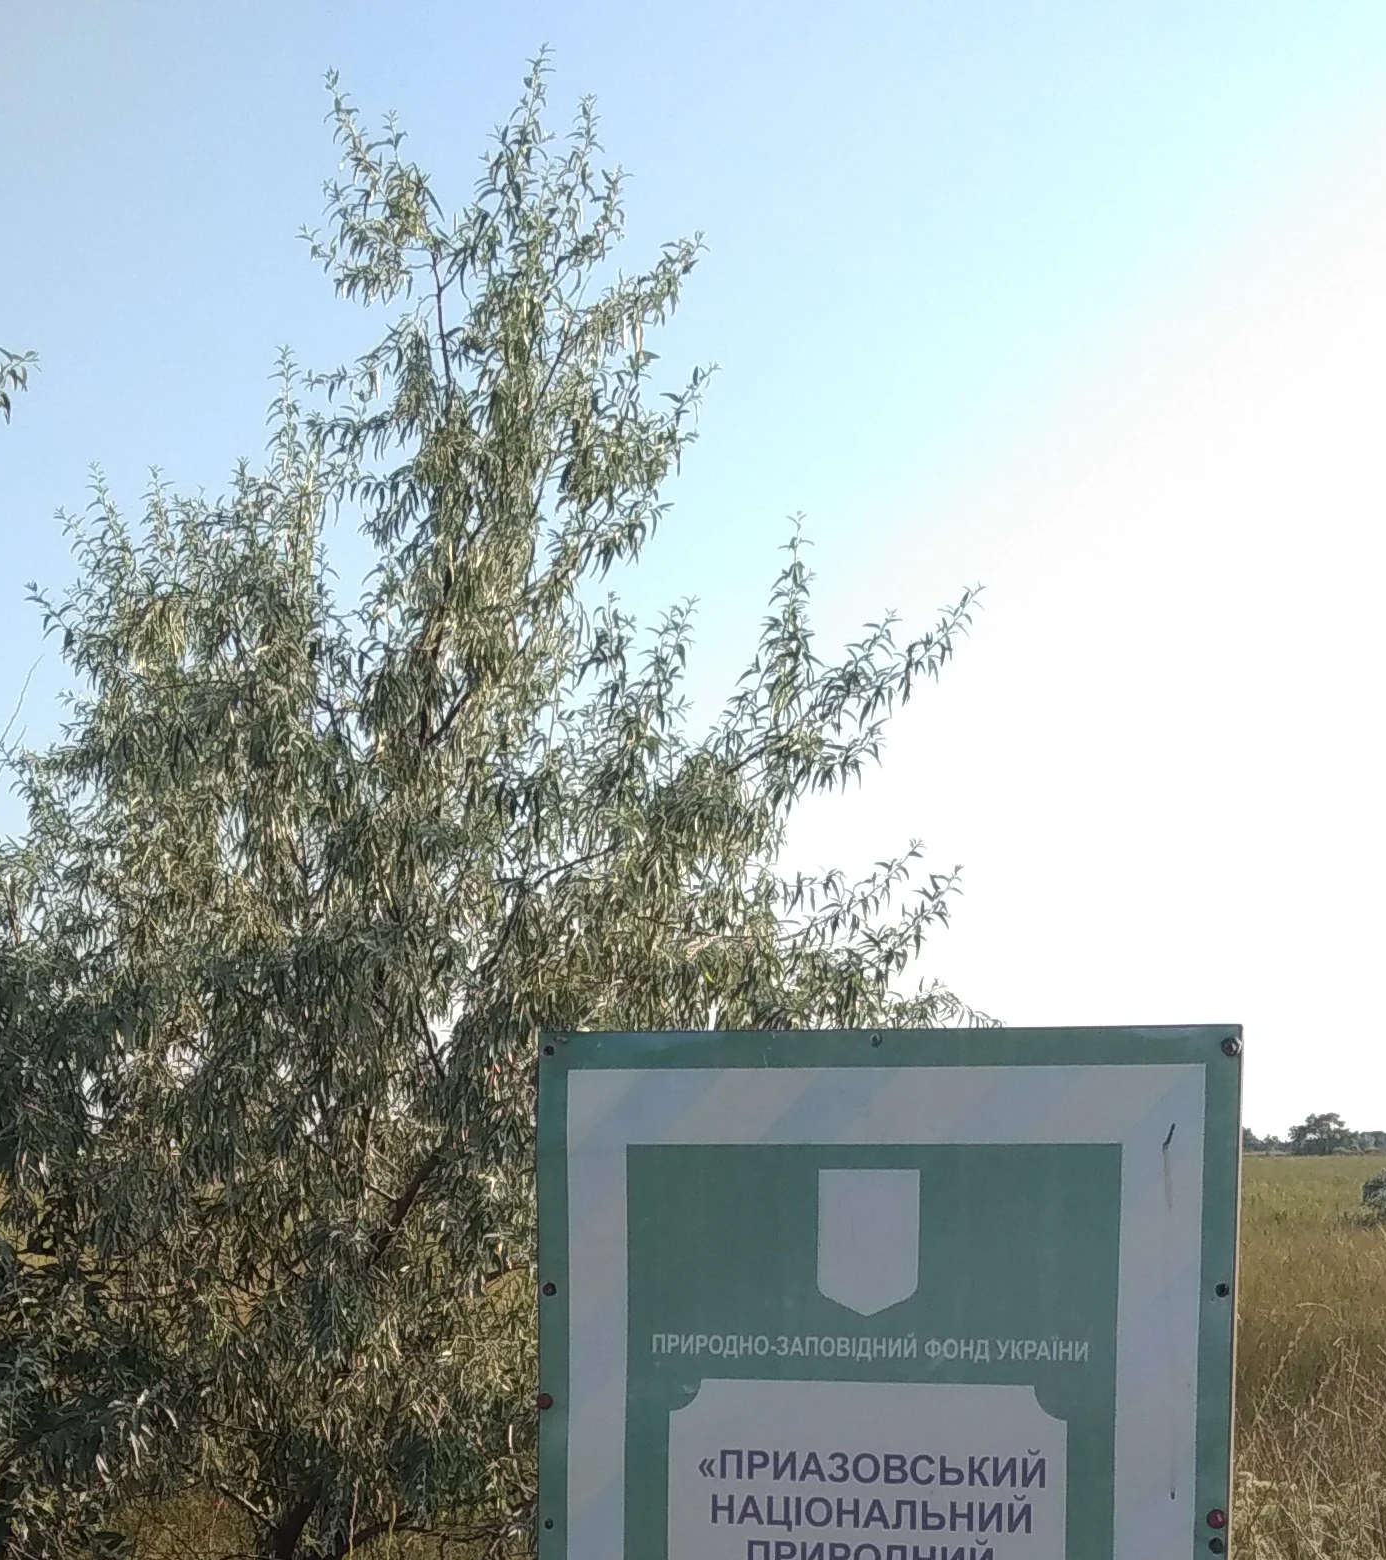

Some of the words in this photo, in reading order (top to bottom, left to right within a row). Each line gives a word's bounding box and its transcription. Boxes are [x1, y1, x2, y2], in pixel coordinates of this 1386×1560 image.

[651, 1332, 918, 1363] ПРИРОДНО-ЗАПОВІДНИЙ
[924, 1338, 990, 1363] ФОНД
[995, 1336, 1090, 1363] УКРАЇНИ
[698, 1449, 1047, 1490] «ПРИАЗОВСЬКИЙ
[711, 1494, 1033, 1535] НАЦІОНАЛЬНИЙ
